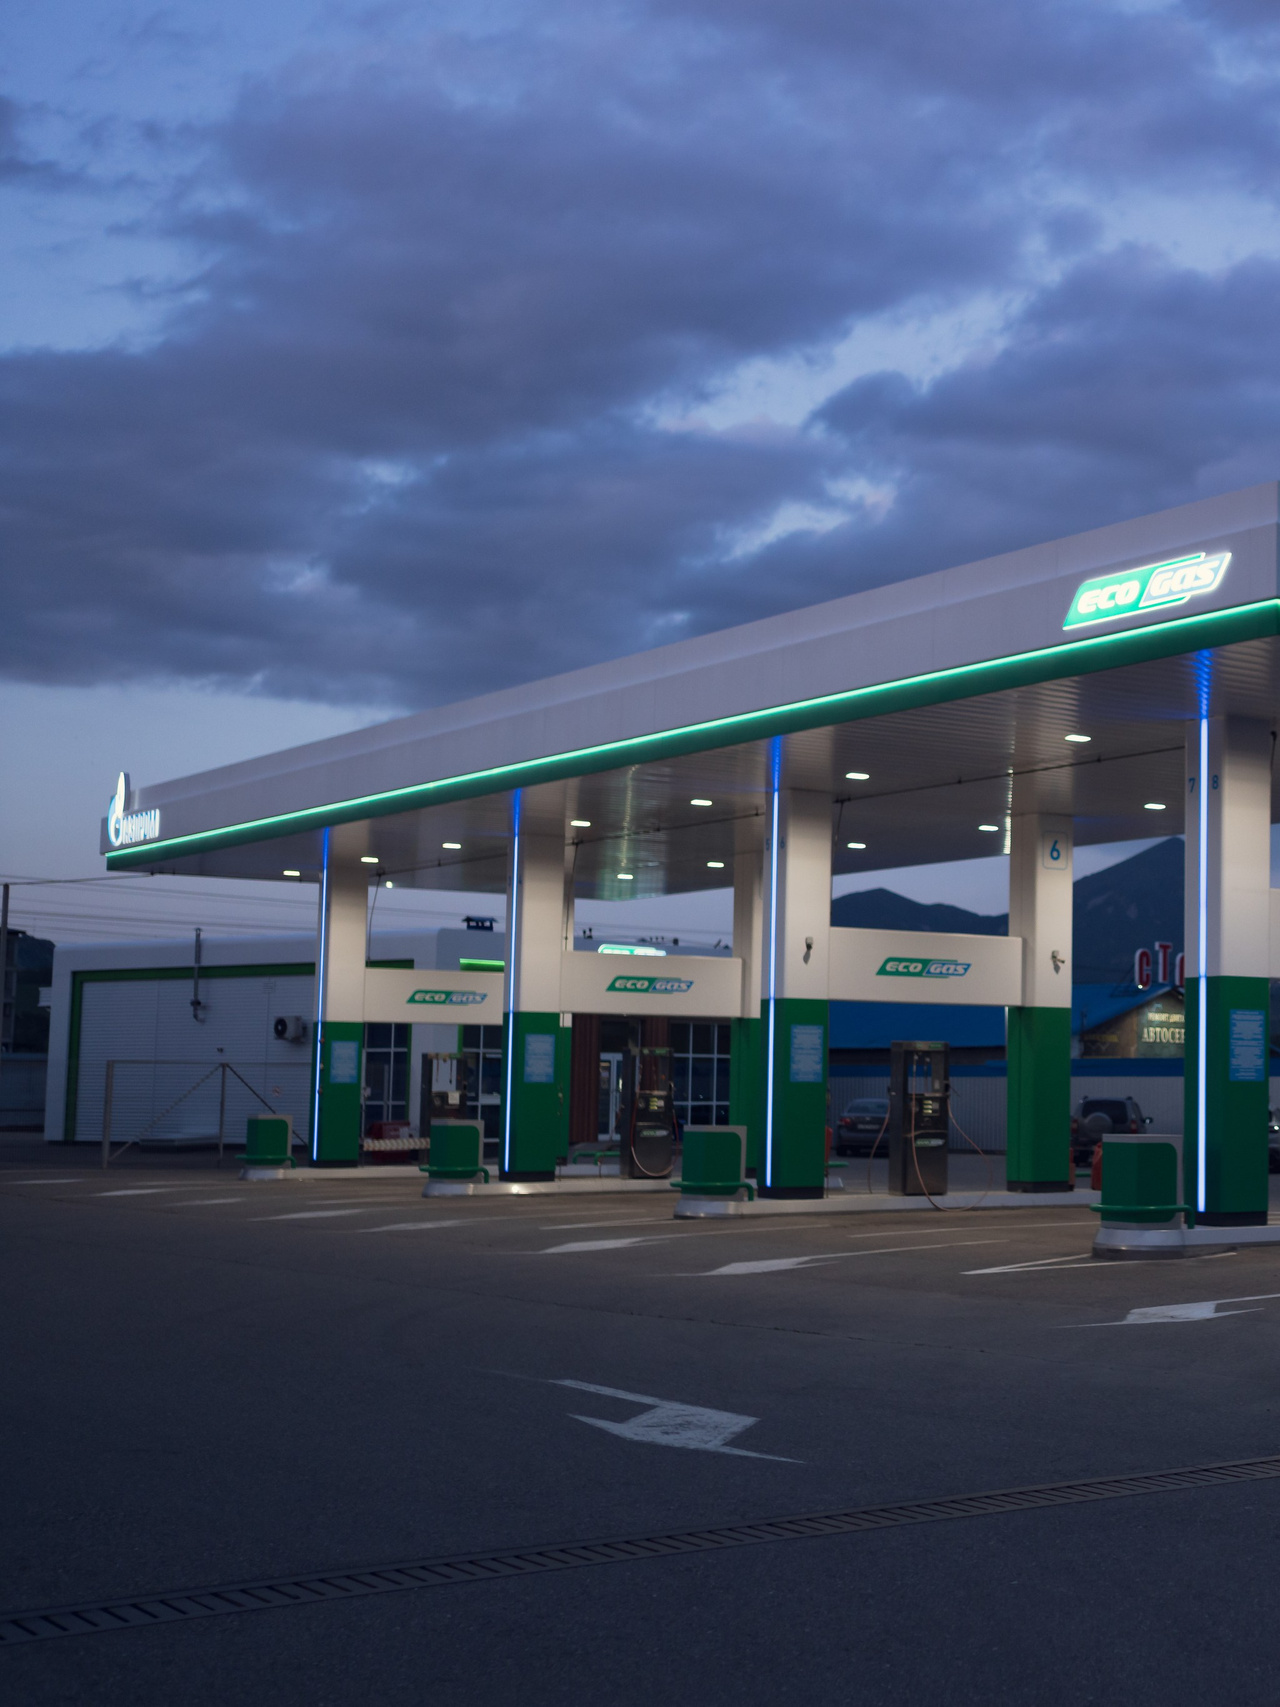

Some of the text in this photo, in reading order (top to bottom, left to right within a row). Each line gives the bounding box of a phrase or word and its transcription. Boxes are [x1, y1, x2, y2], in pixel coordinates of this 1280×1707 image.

[1188, 777, 1196, 793] 7
[1211, 774, 1219, 790] 8
[1049, 839, 1060, 861] 6
